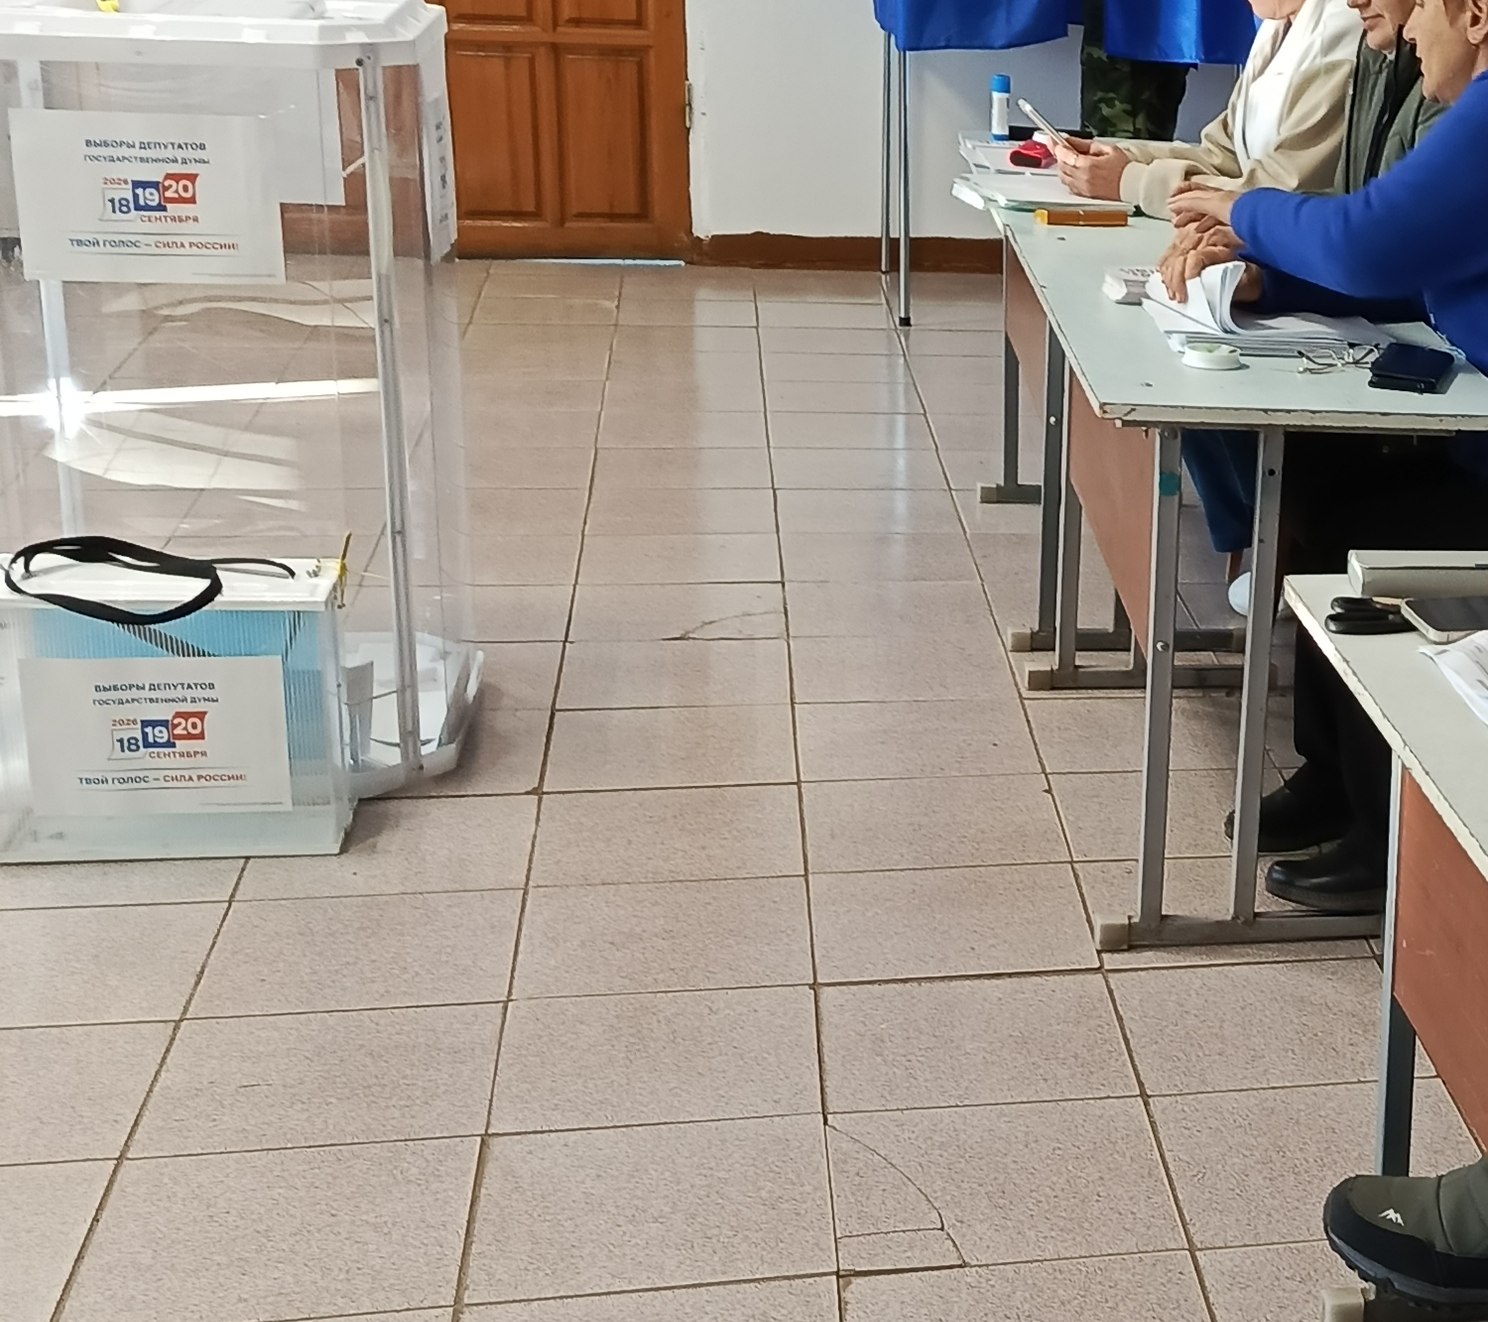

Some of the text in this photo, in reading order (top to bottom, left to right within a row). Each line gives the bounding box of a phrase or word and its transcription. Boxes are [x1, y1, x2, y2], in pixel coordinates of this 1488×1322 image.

[85, 139, 206, 151] ВЫБОРЫ ДЕПУТАТОВ
[84, 154, 210, 165] ГОСУДАРСТВЕННОЙ ДУМЫ
[103, 177, 129, 186] 2026
[107, 179, 193, 214] 18 19 20
[140, 214, 199, 224] СЕНТЯБРЯ
[69, 238, 100, 248] ТВОЙ
[103, 239, 141, 248] ГОЛОС
[154, 240, 186, 249] СИЛА
[94, 682, 215, 692] ВЫБОРЫ ДЕПУТАТОВ
[93, 695, 188, 705] ГОСУДАРСТВЕННОЙ
[112, 718, 138, 727] 2026
[116, 717, 202, 753] 18 19 20
[149, 750, 208, 759] СЕНТЯБРЯ
[78, 775, 109, 785] ТВОЙ
[111, 775, 149, 785] ГОЛОС
[163, 774, 194, 783] СИЛА
